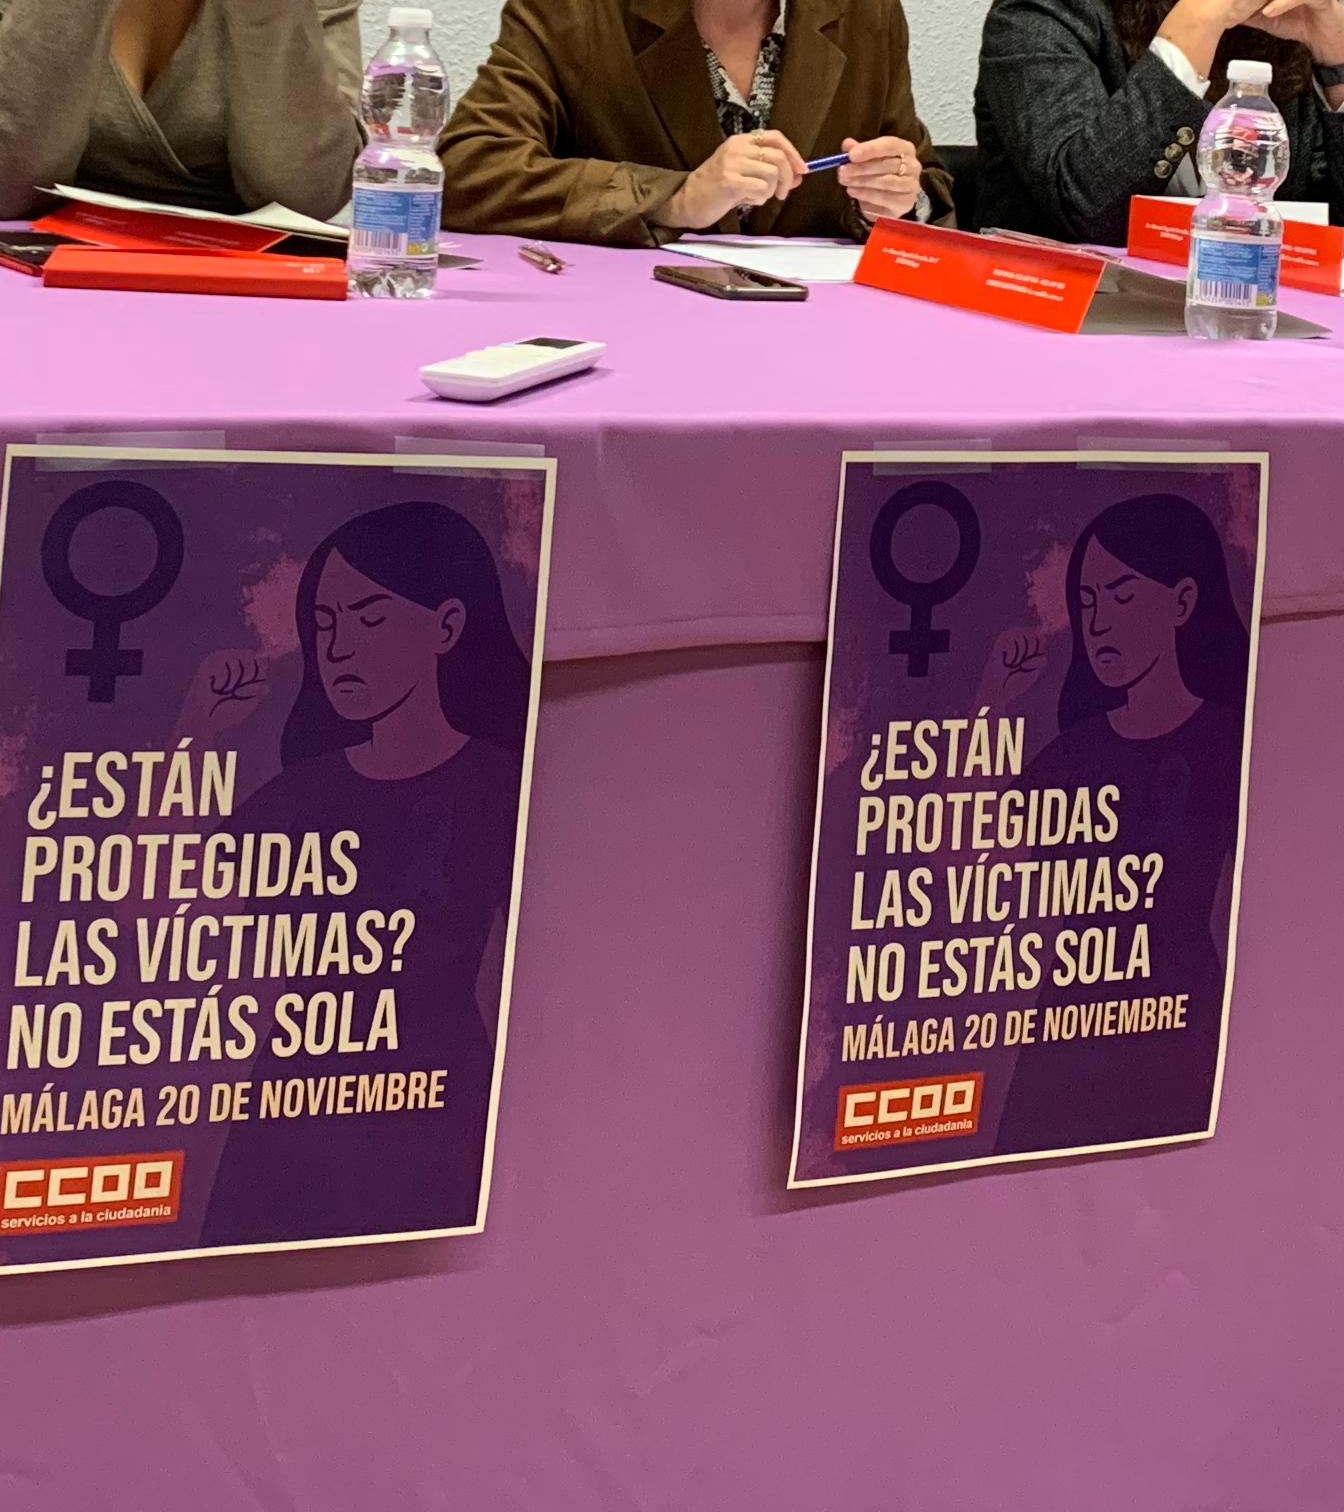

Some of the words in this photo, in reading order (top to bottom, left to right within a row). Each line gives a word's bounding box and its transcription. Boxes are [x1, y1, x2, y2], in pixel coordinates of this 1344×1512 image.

[28, 738, 237, 829] ¿ESTÁN
[861, 707, 1024, 791] ¿ESTÁN
[857, 785, 1119, 855] PROTEGIDAS
[22, 831, 359, 902] PROTEGIDAS
[852, 868, 932, 929] LAS
[947, 853, 1163, 923] VÍCTIMAS?
[15, 918, 118, 986] LAS
[137, 903, 415, 982] VÍCTIMAS?
[847, 943, 905, 1003] NO
[918, 924, 1042, 998] ESTÁS
[1053, 924, 1150, 986] SOLA
[7, 1003, 82, 1069] NO
[98, 985, 258, 1065] ESTÁS
[272, 989, 398, 1057] SOLA
[842, 1015, 954, 1061] MÁLAGA
[963, 1013, 997, 1050] 20
[1004, 1009, 1037, 1045] DE
[1043, 994, 1188, 1041] NOVIEMBRE
[1, 1083, 144, 1134] MÁLAGA
[156, 1085, 200, 1125] 20
[209, 1082, 251, 1122] DE
[260, 1070, 447, 1118] NOVIEMBRE
[842, 1129, 891, 1145] servicios
[893, 1129, 900, 1138] a
[903, 1126, 912, 1137] la
[844, 1081, 975, 1129] CCOO
[4, 1161, 172, 1208] CCOO
[1, 1213, 65, 1229] servicios
[69, 1215, 77, 1224] a
[81, 1211, 93, 1223] la
